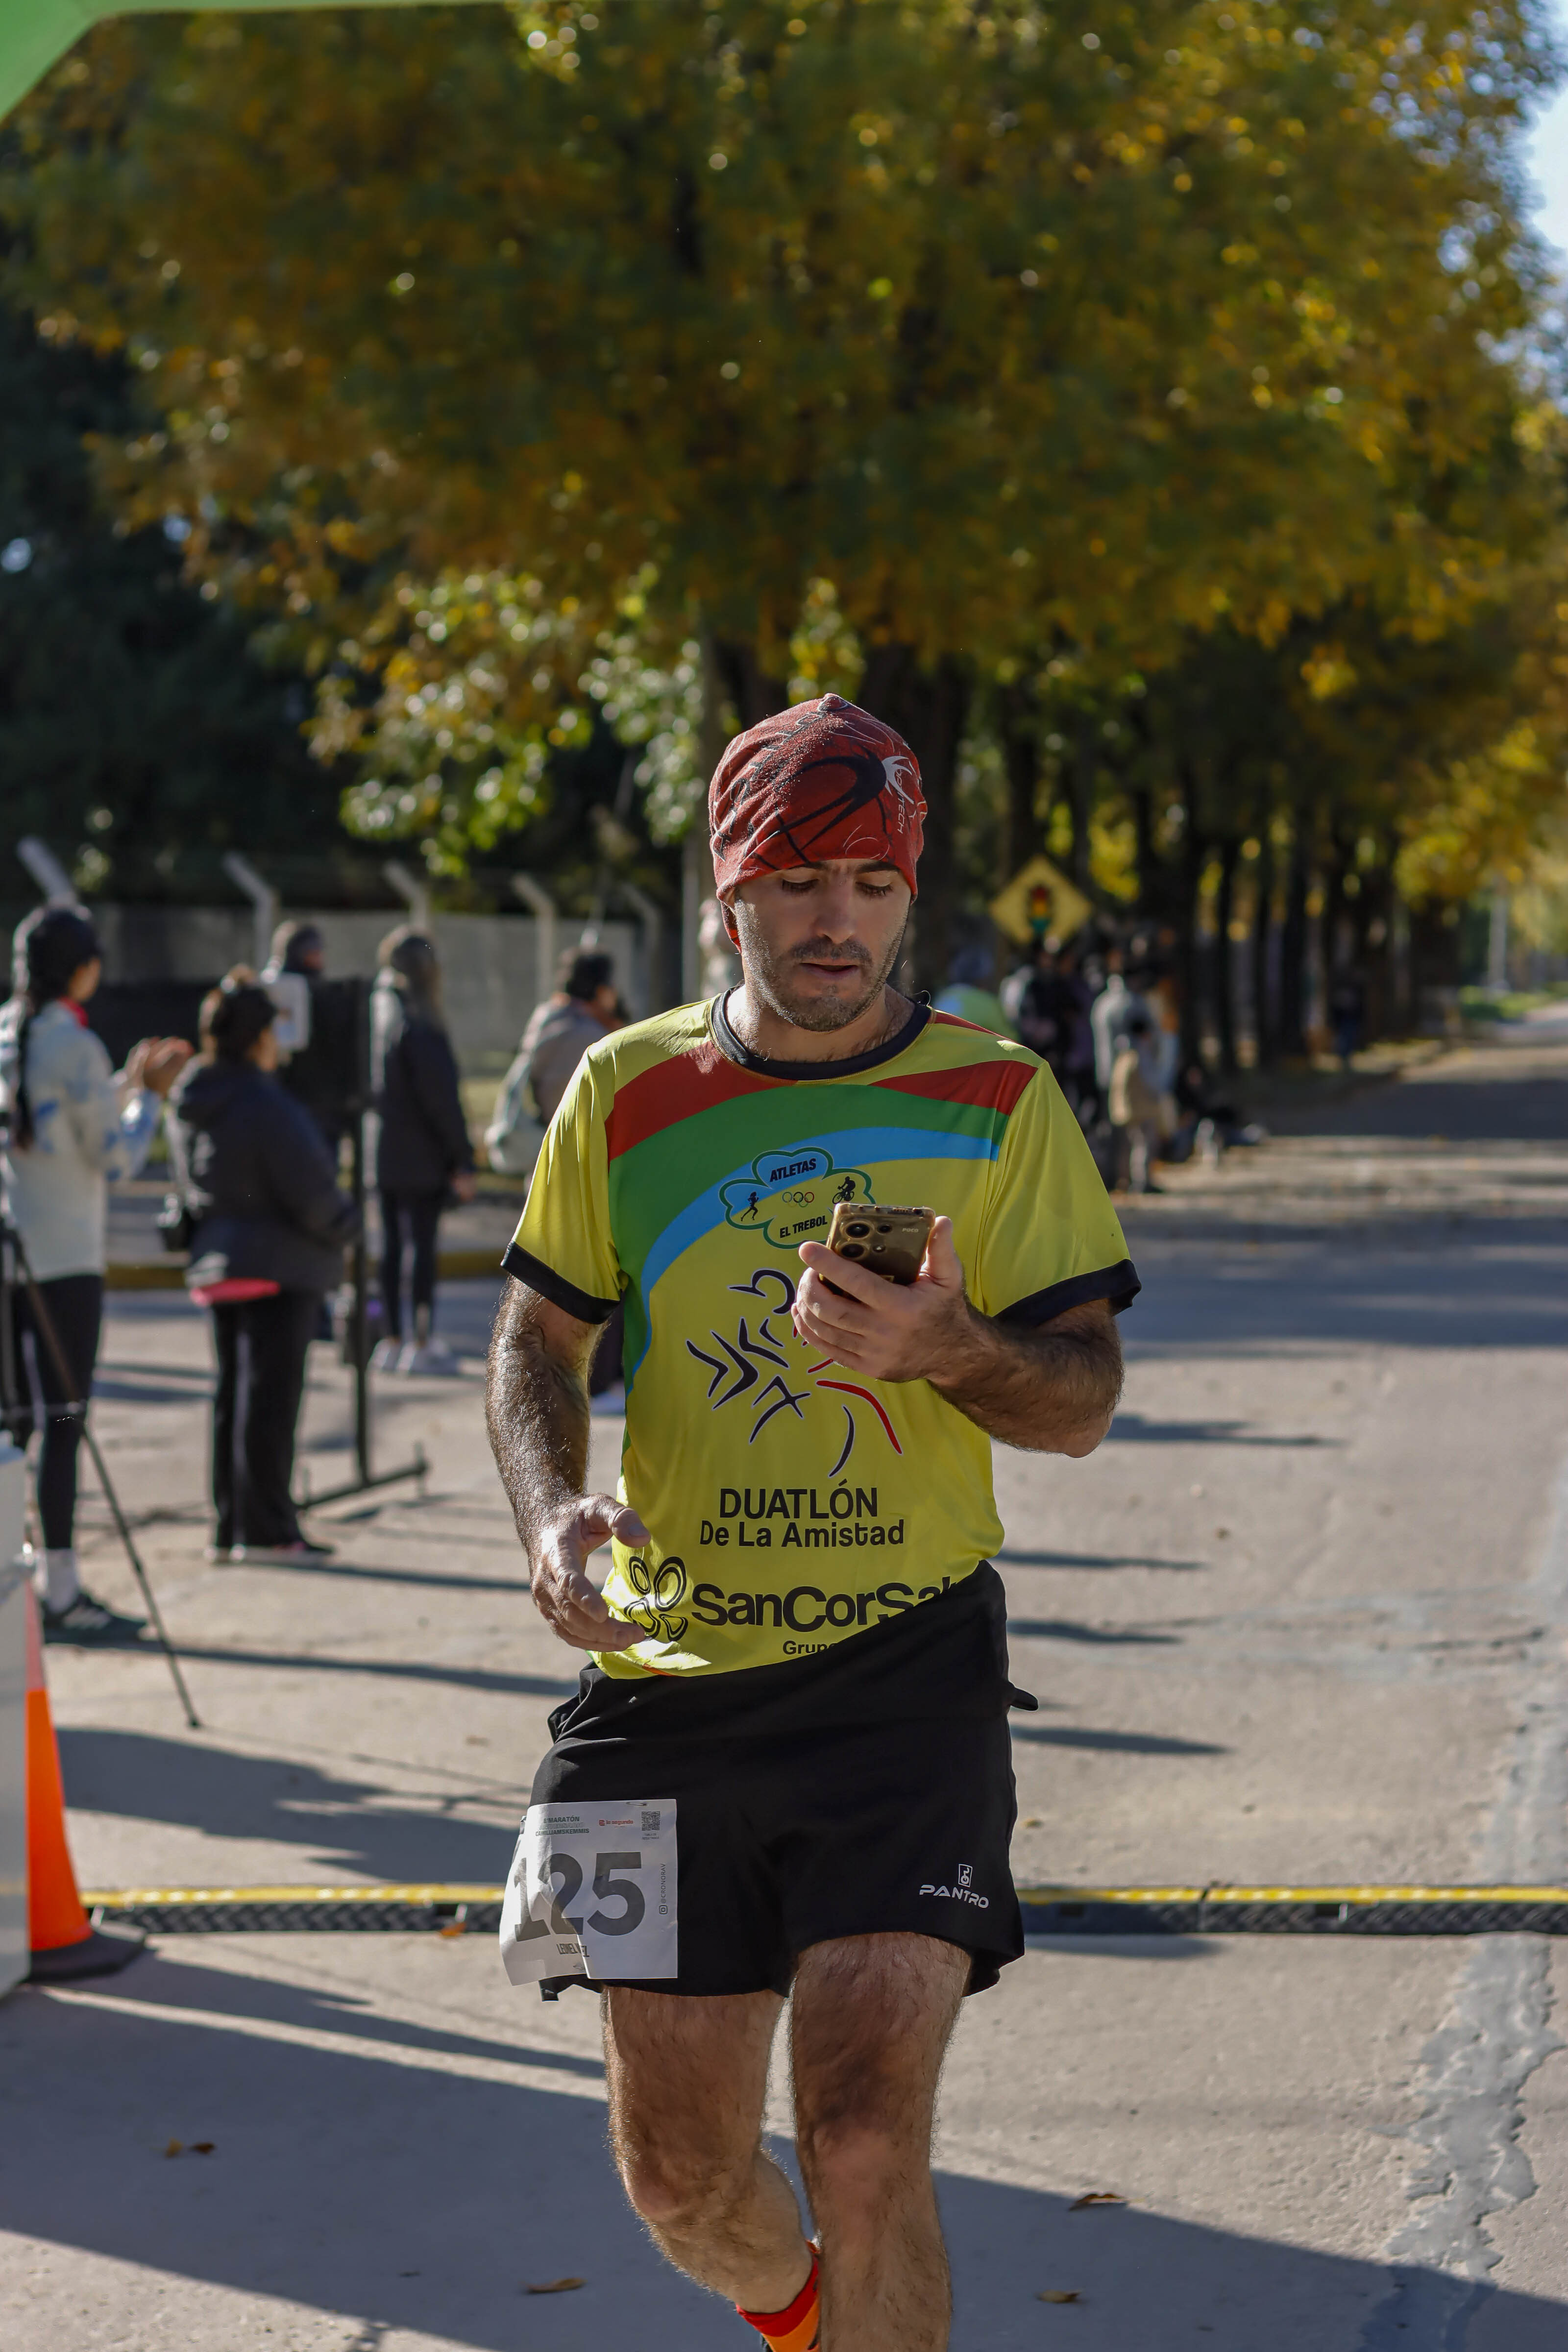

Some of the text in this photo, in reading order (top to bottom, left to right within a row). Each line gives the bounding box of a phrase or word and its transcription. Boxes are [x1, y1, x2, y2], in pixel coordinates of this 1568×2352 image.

[896, 768, 906, 834] OPITECH
[770, 1157, 817, 1182] ATLETAS
[780, 1215, 828, 1239] EL TREBOL
[720, 1479, 878, 1519] DUATLÓN
[700, 1519, 905, 1548] De La Amistad
[691, 1576, 956, 1632] SanCorS
[514, 1852, 645, 1942] 125
[919, 1885, 989, 1909] PANTRO
